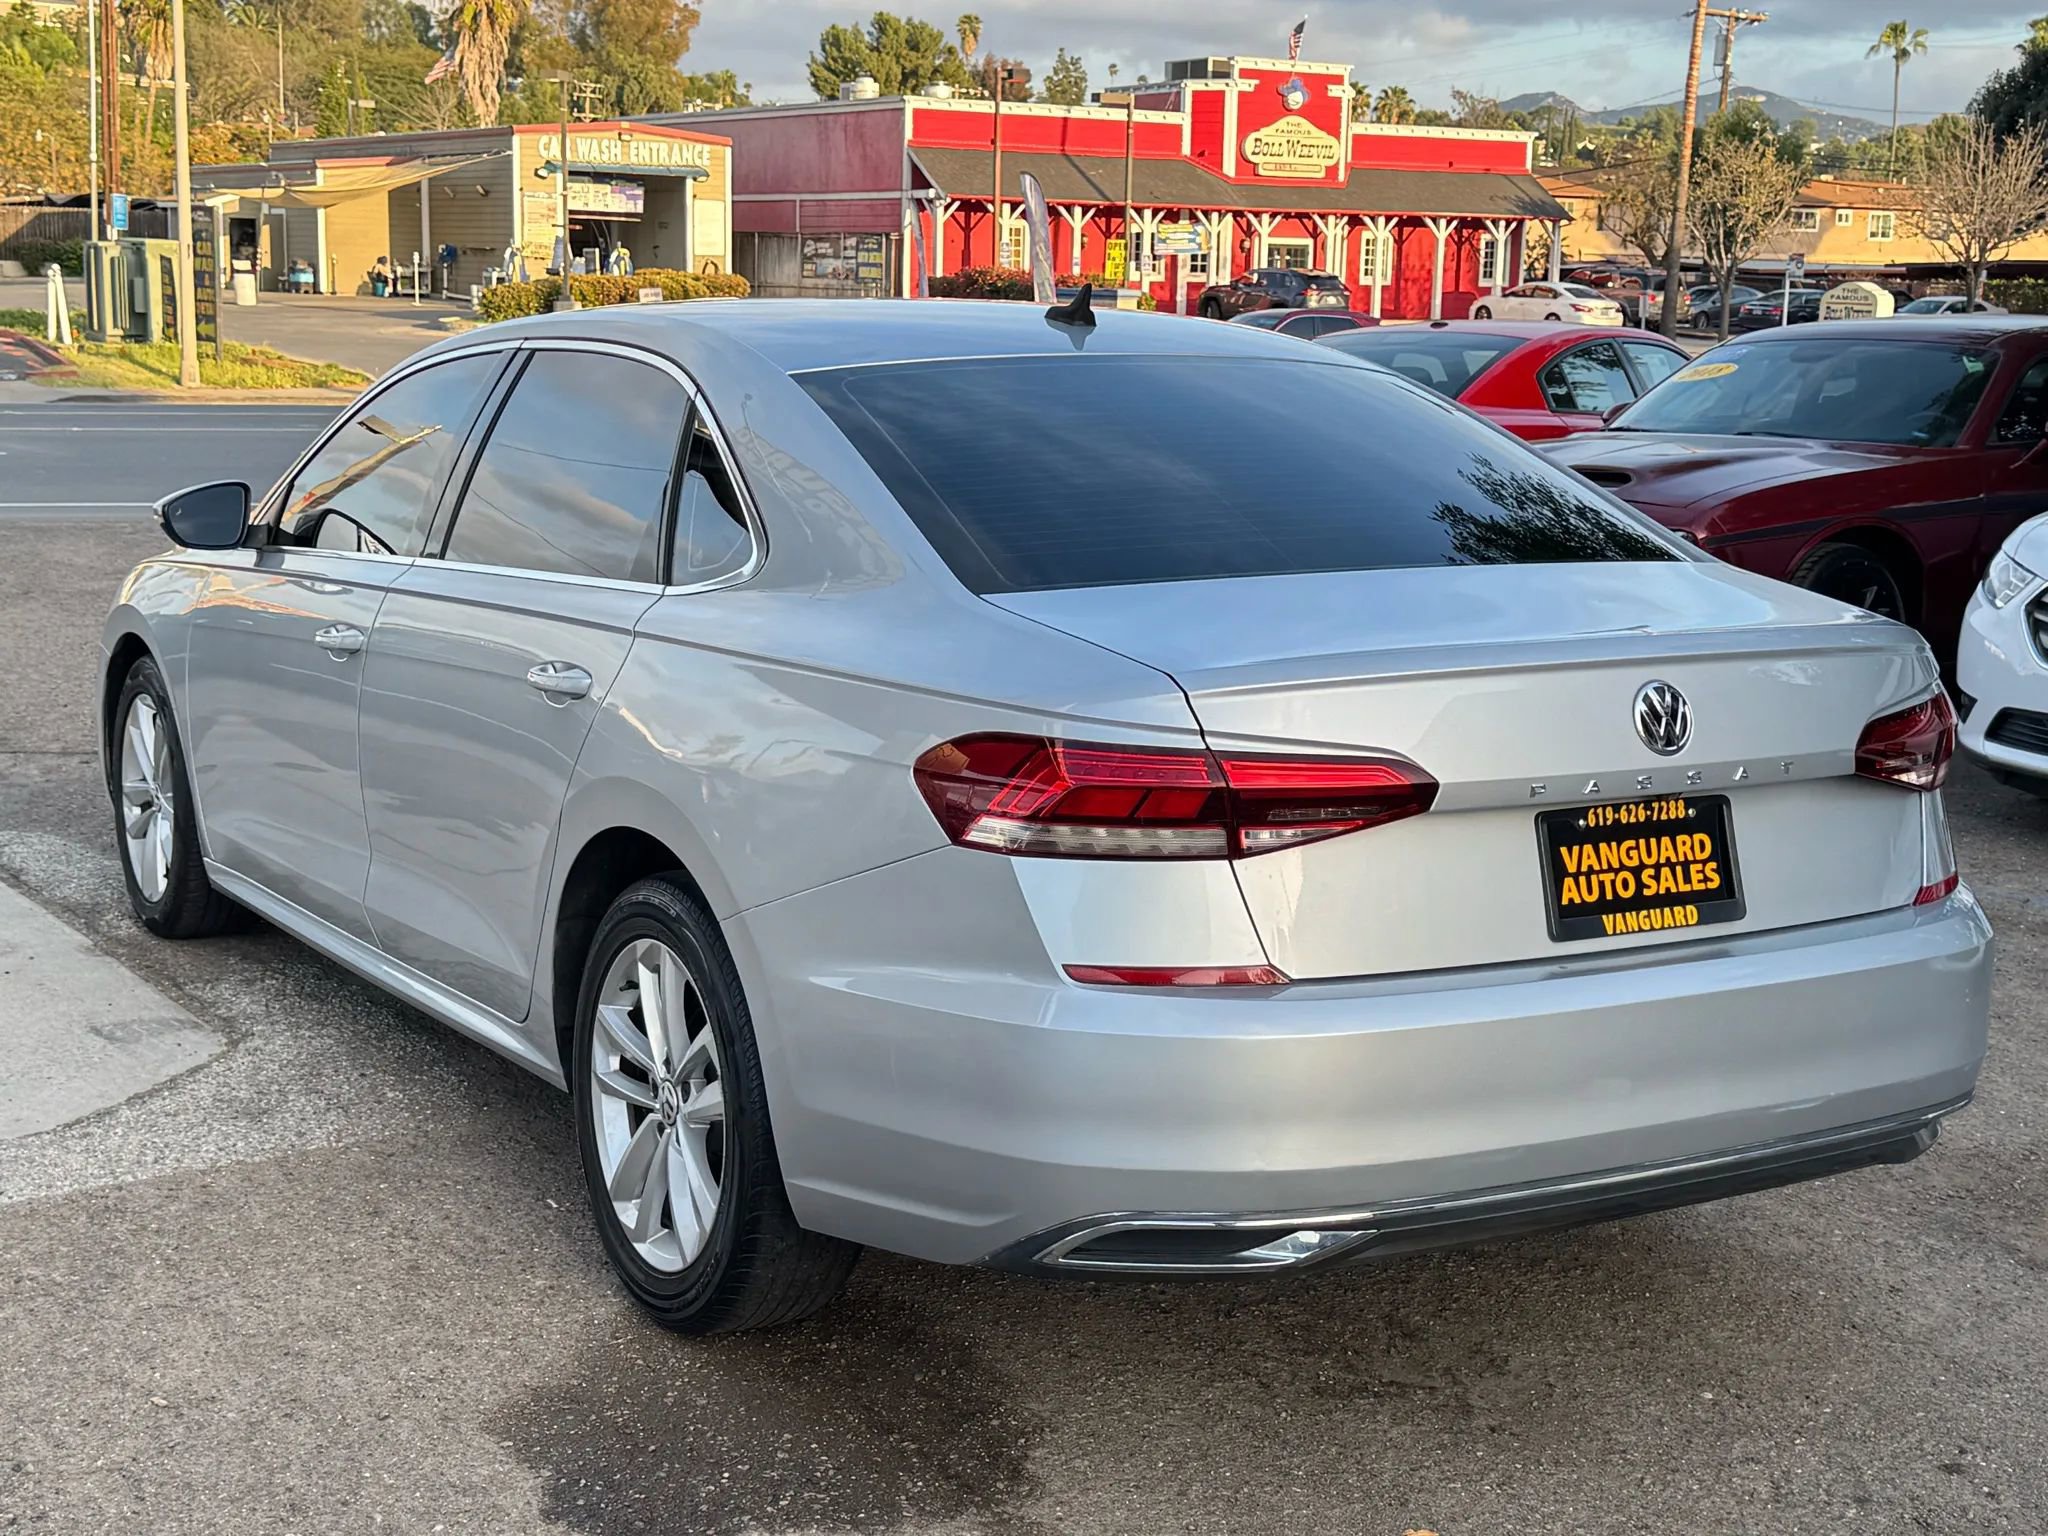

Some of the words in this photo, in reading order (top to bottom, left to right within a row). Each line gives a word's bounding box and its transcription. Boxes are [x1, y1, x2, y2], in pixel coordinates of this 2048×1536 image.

[1275, 128, 1312, 136] FAMOUS
[576, 137, 622, 161] WASH
[629, 141, 711, 166] ENTRANCE
[1251, 137, 1283, 157] BOLL
[1286, 139, 1335, 159] WEEVIL
[1830, 294, 1870, 302] FAMOUS
[1530, 760, 1794, 798] PASSAT
[1587, 799, 1686, 828] 619-626-7288
[1560, 832, 1713, 874] VANGUARD
[1561, 870, 1636, 905] AUTO
[1641, 861, 1721, 897] SALES
[1601, 904, 1699, 935] VANGUARD
